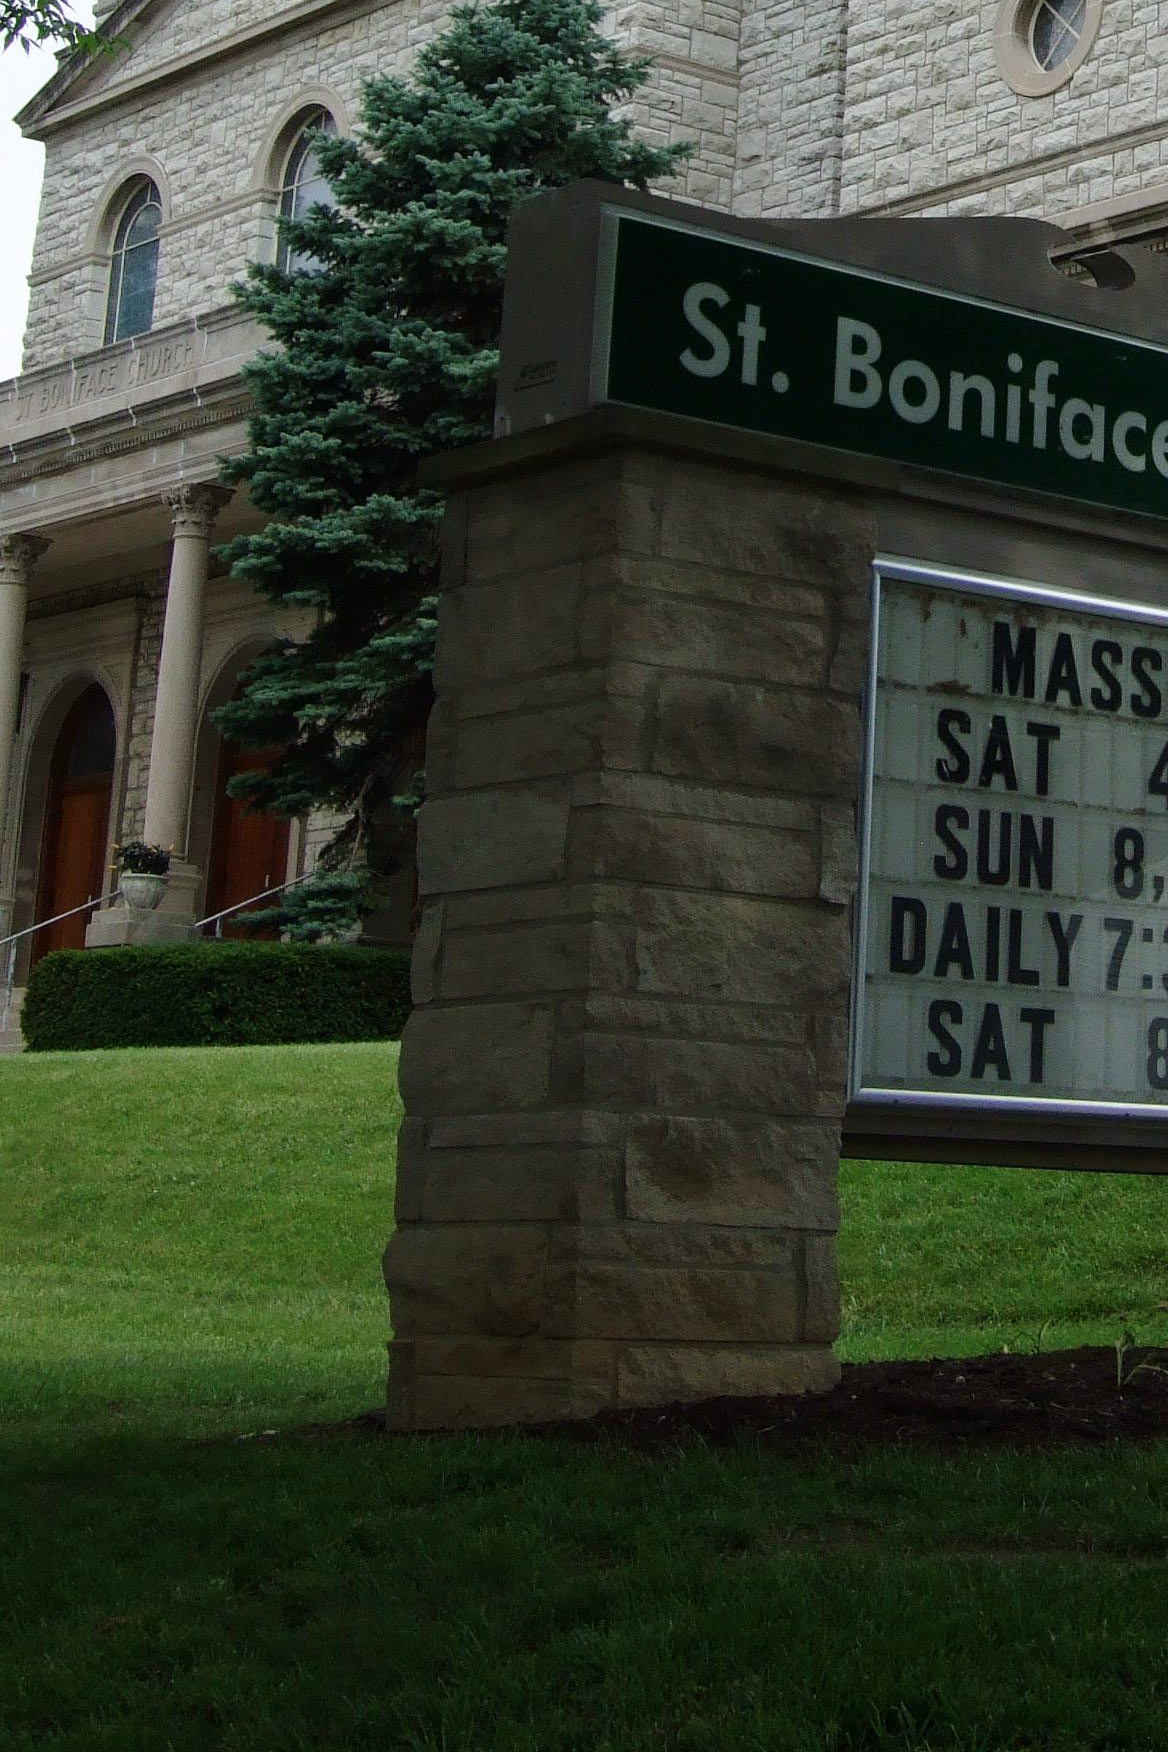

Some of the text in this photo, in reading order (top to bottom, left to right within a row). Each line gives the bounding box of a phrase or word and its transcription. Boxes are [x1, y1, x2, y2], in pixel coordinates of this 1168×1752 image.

[129, 342, 194, 386] CHURCH
[680, 283, 789, 394] St.
[936, 708, 1060, 797] SAT
[933, 804, 1054, 891] SUN
[889, 895, 1084, 988] DAILY
[926, 999, 1056, 1087] SAT
